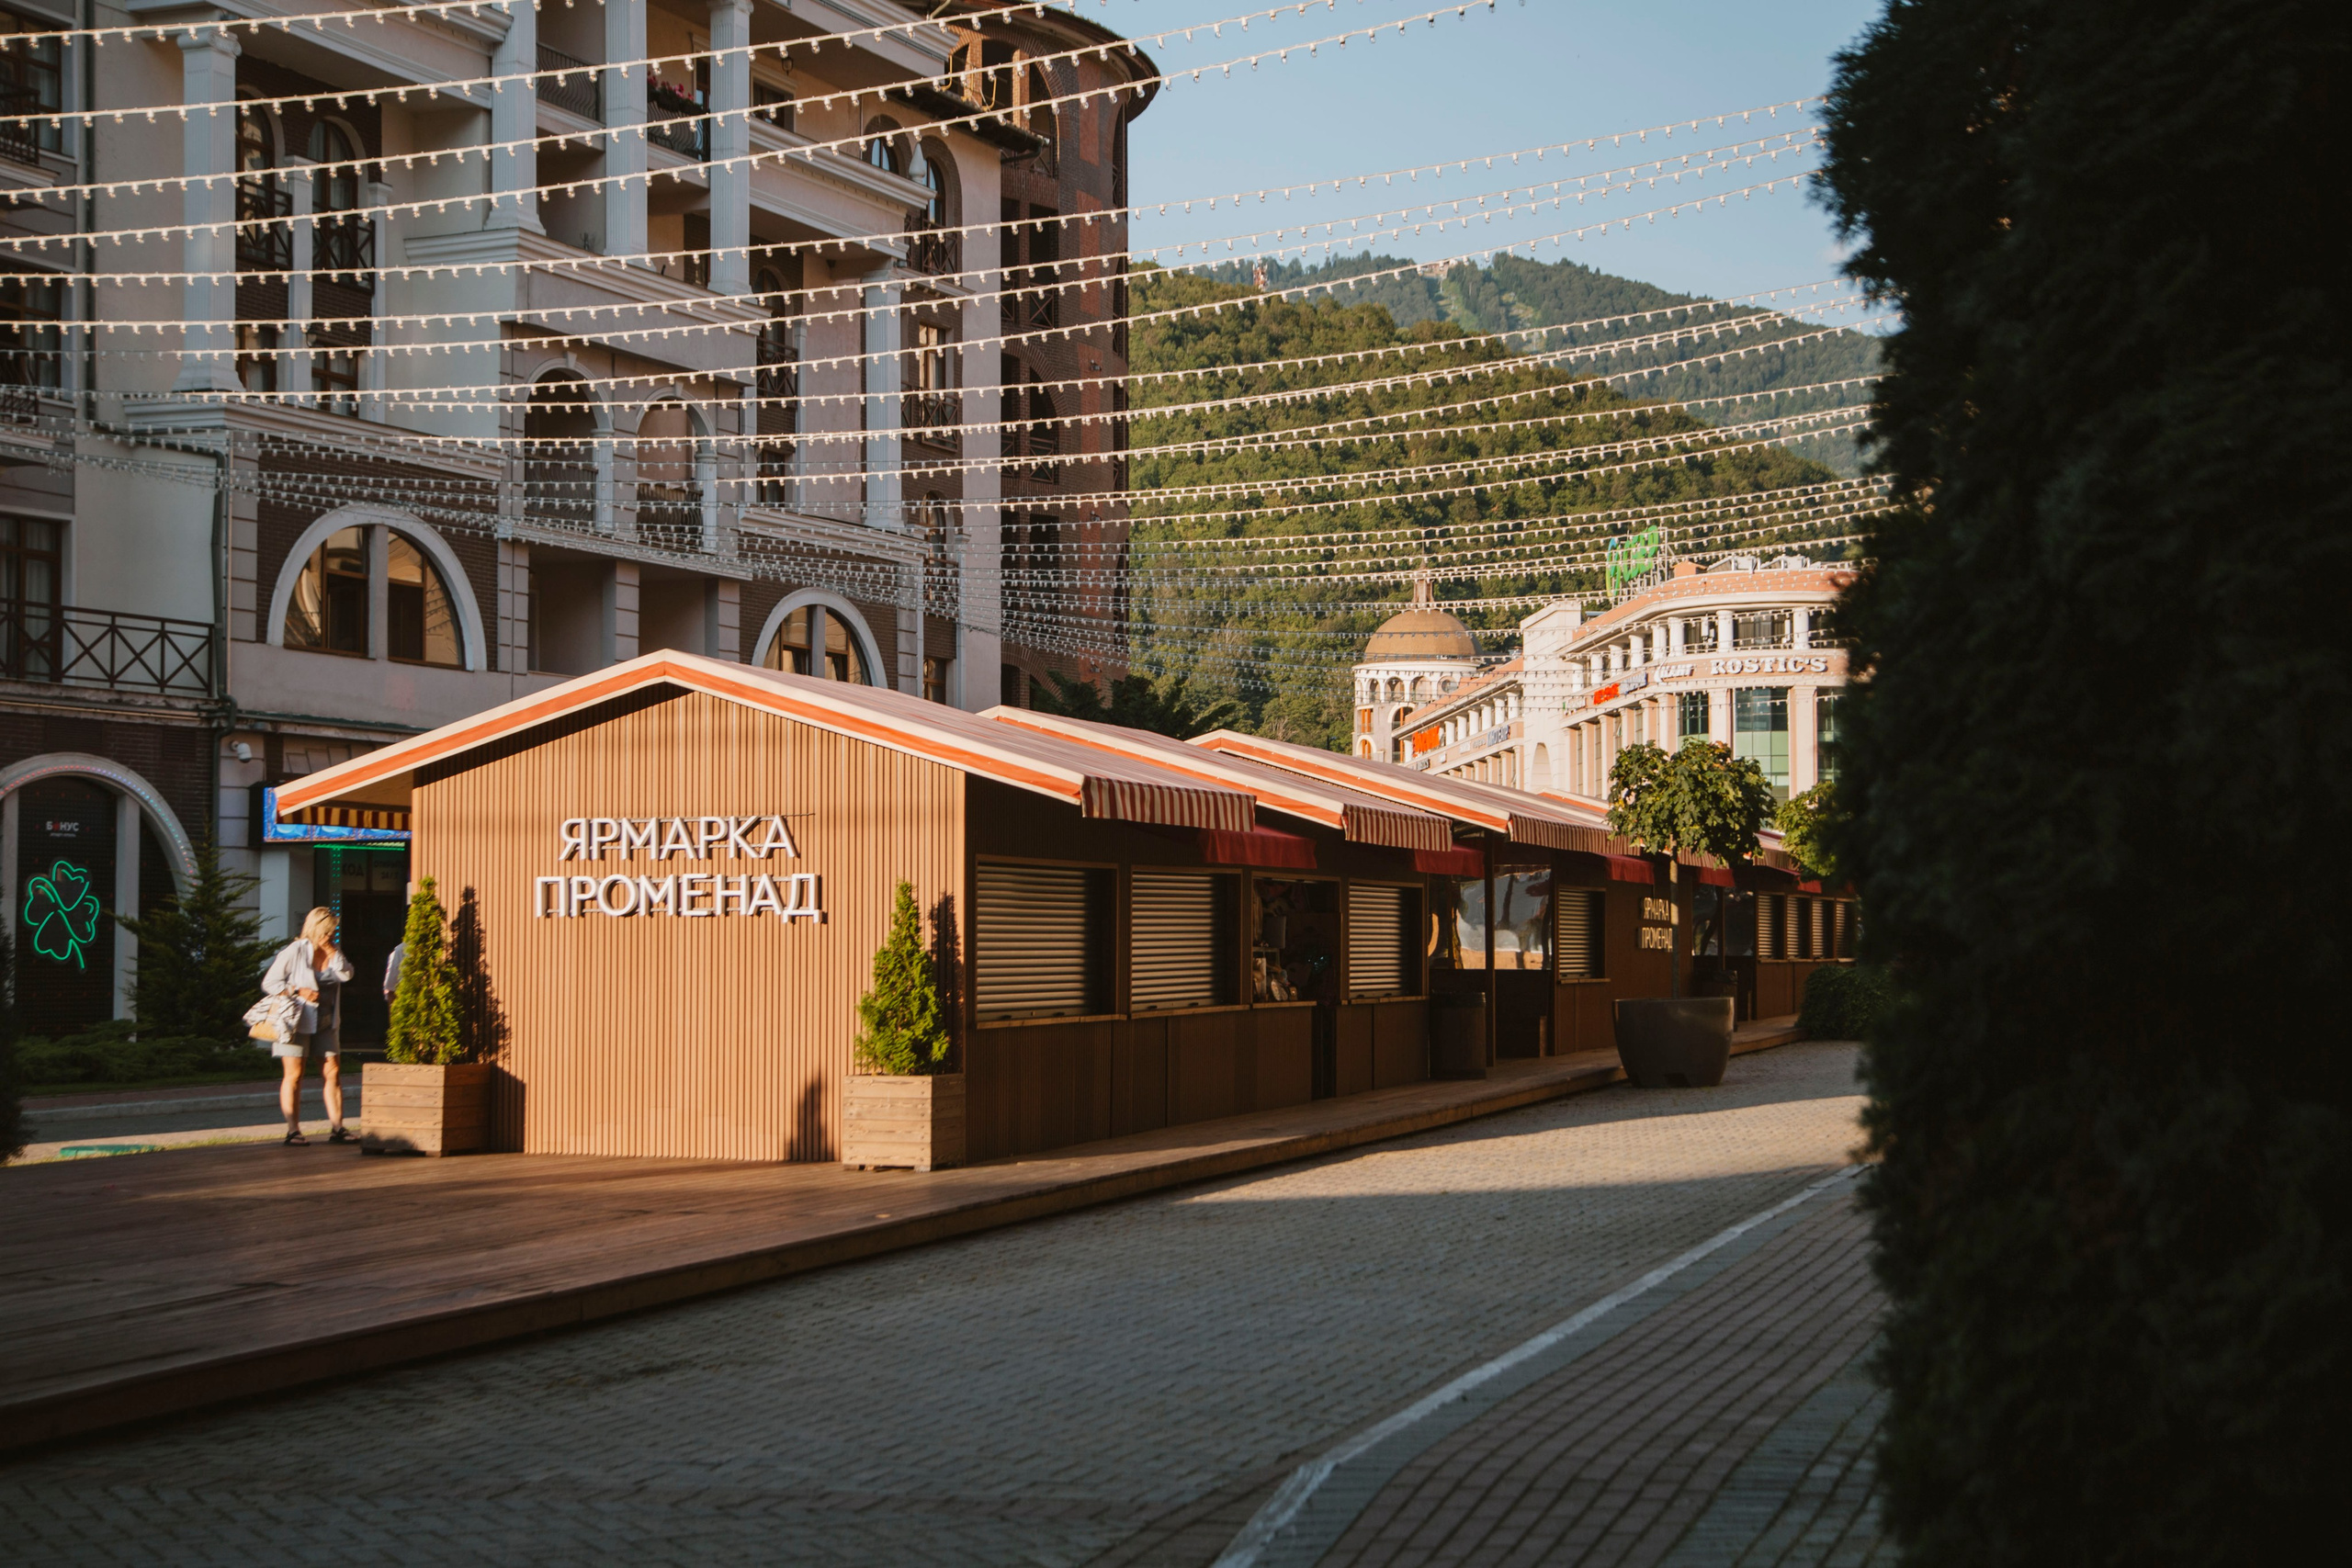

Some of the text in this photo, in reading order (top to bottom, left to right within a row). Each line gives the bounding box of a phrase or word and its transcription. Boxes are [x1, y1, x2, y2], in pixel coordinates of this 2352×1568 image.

[1710, 656, 1828, 675] ROSTIC'S
[559, 815, 798, 860] ЯРМАРКА
[536, 874, 824, 924] ПРОМЕНАД
[1643, 897, 1670, 921] ЯРМАРКА
[1641, 926, 1673, 953] ПРОМЕНАД
